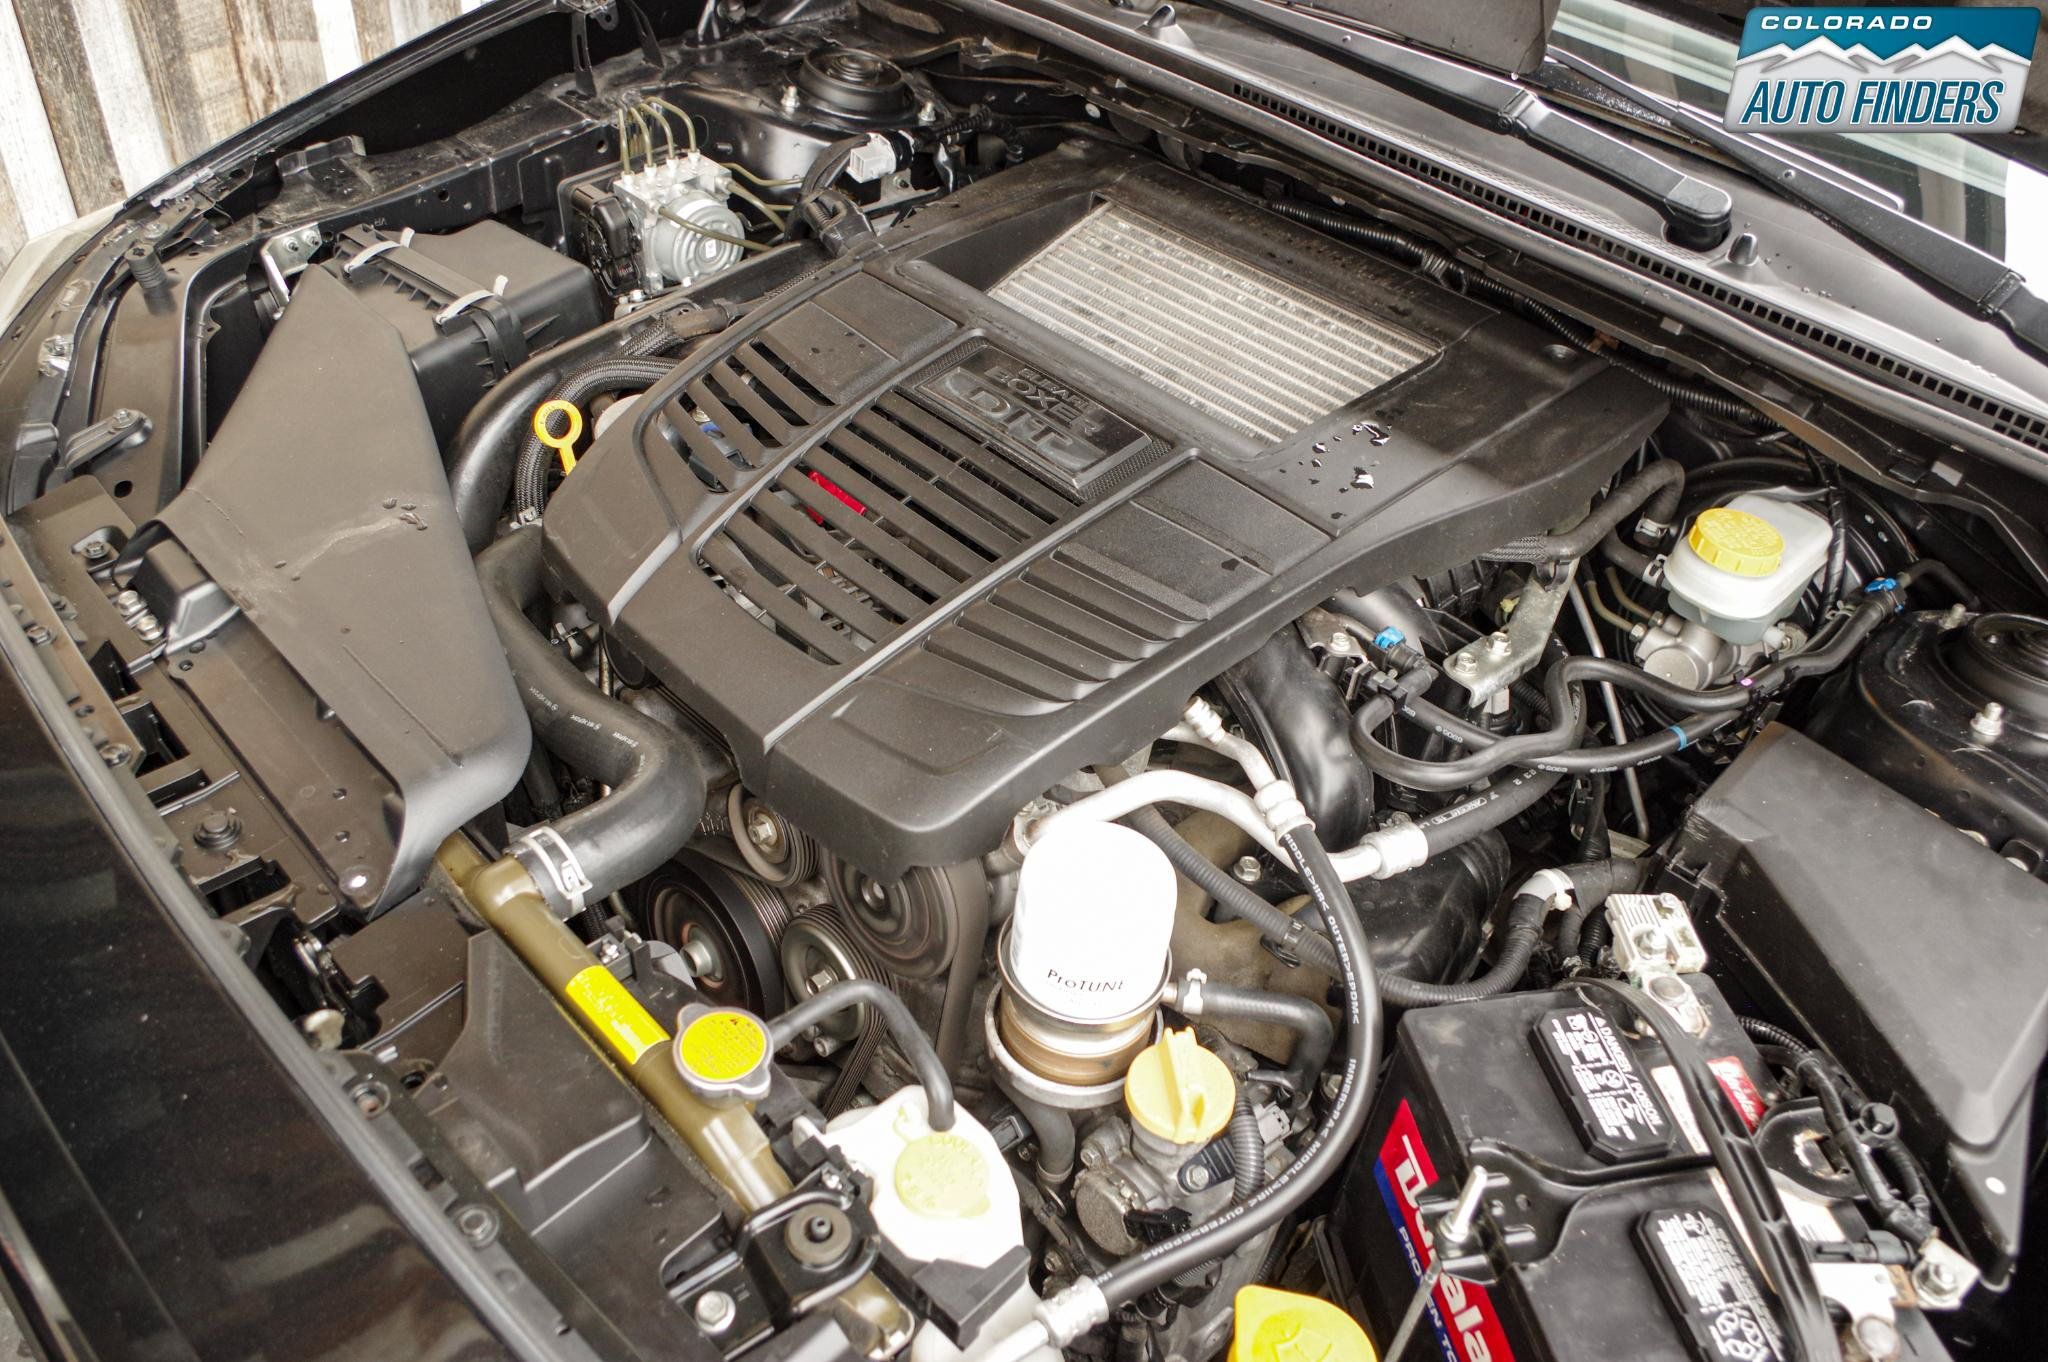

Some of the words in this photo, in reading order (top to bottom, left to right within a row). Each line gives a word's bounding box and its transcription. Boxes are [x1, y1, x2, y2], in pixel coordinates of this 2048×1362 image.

[983, 366, 1105, 437] BOXER
[1600, 1027, 1633, 1073] DANGER
[1632, 1081, 1664, 1125] POISON
[1399, 1226, 1443, 1328] PROEN
